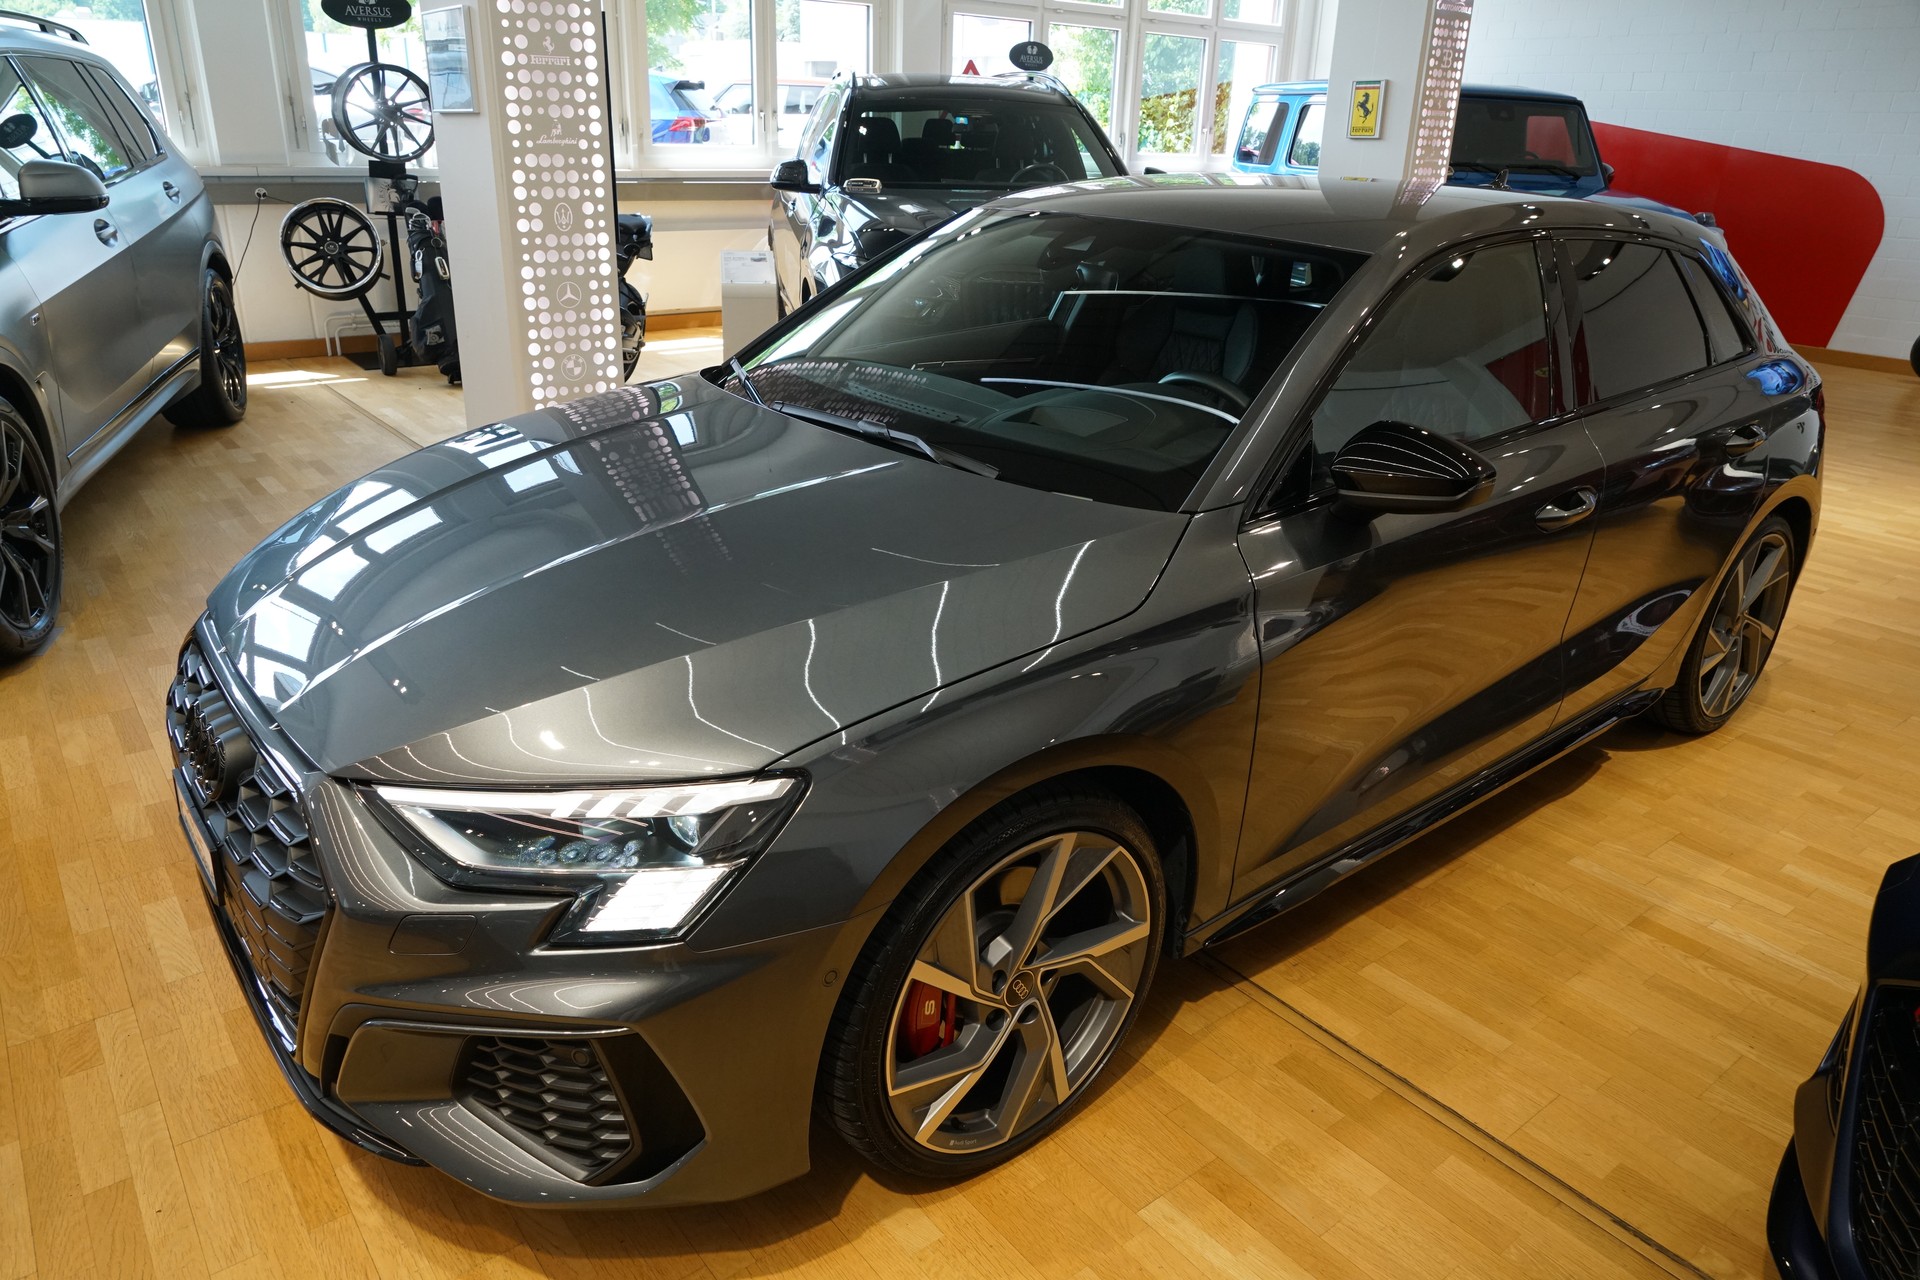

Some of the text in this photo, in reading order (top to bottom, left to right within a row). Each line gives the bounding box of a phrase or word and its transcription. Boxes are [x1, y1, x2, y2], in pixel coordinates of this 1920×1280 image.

[345, 5, 392, 17] AVERSUS
[530, 55, 571, 65] Ferrari
[536, 134, 578, 146] Lamborghini
